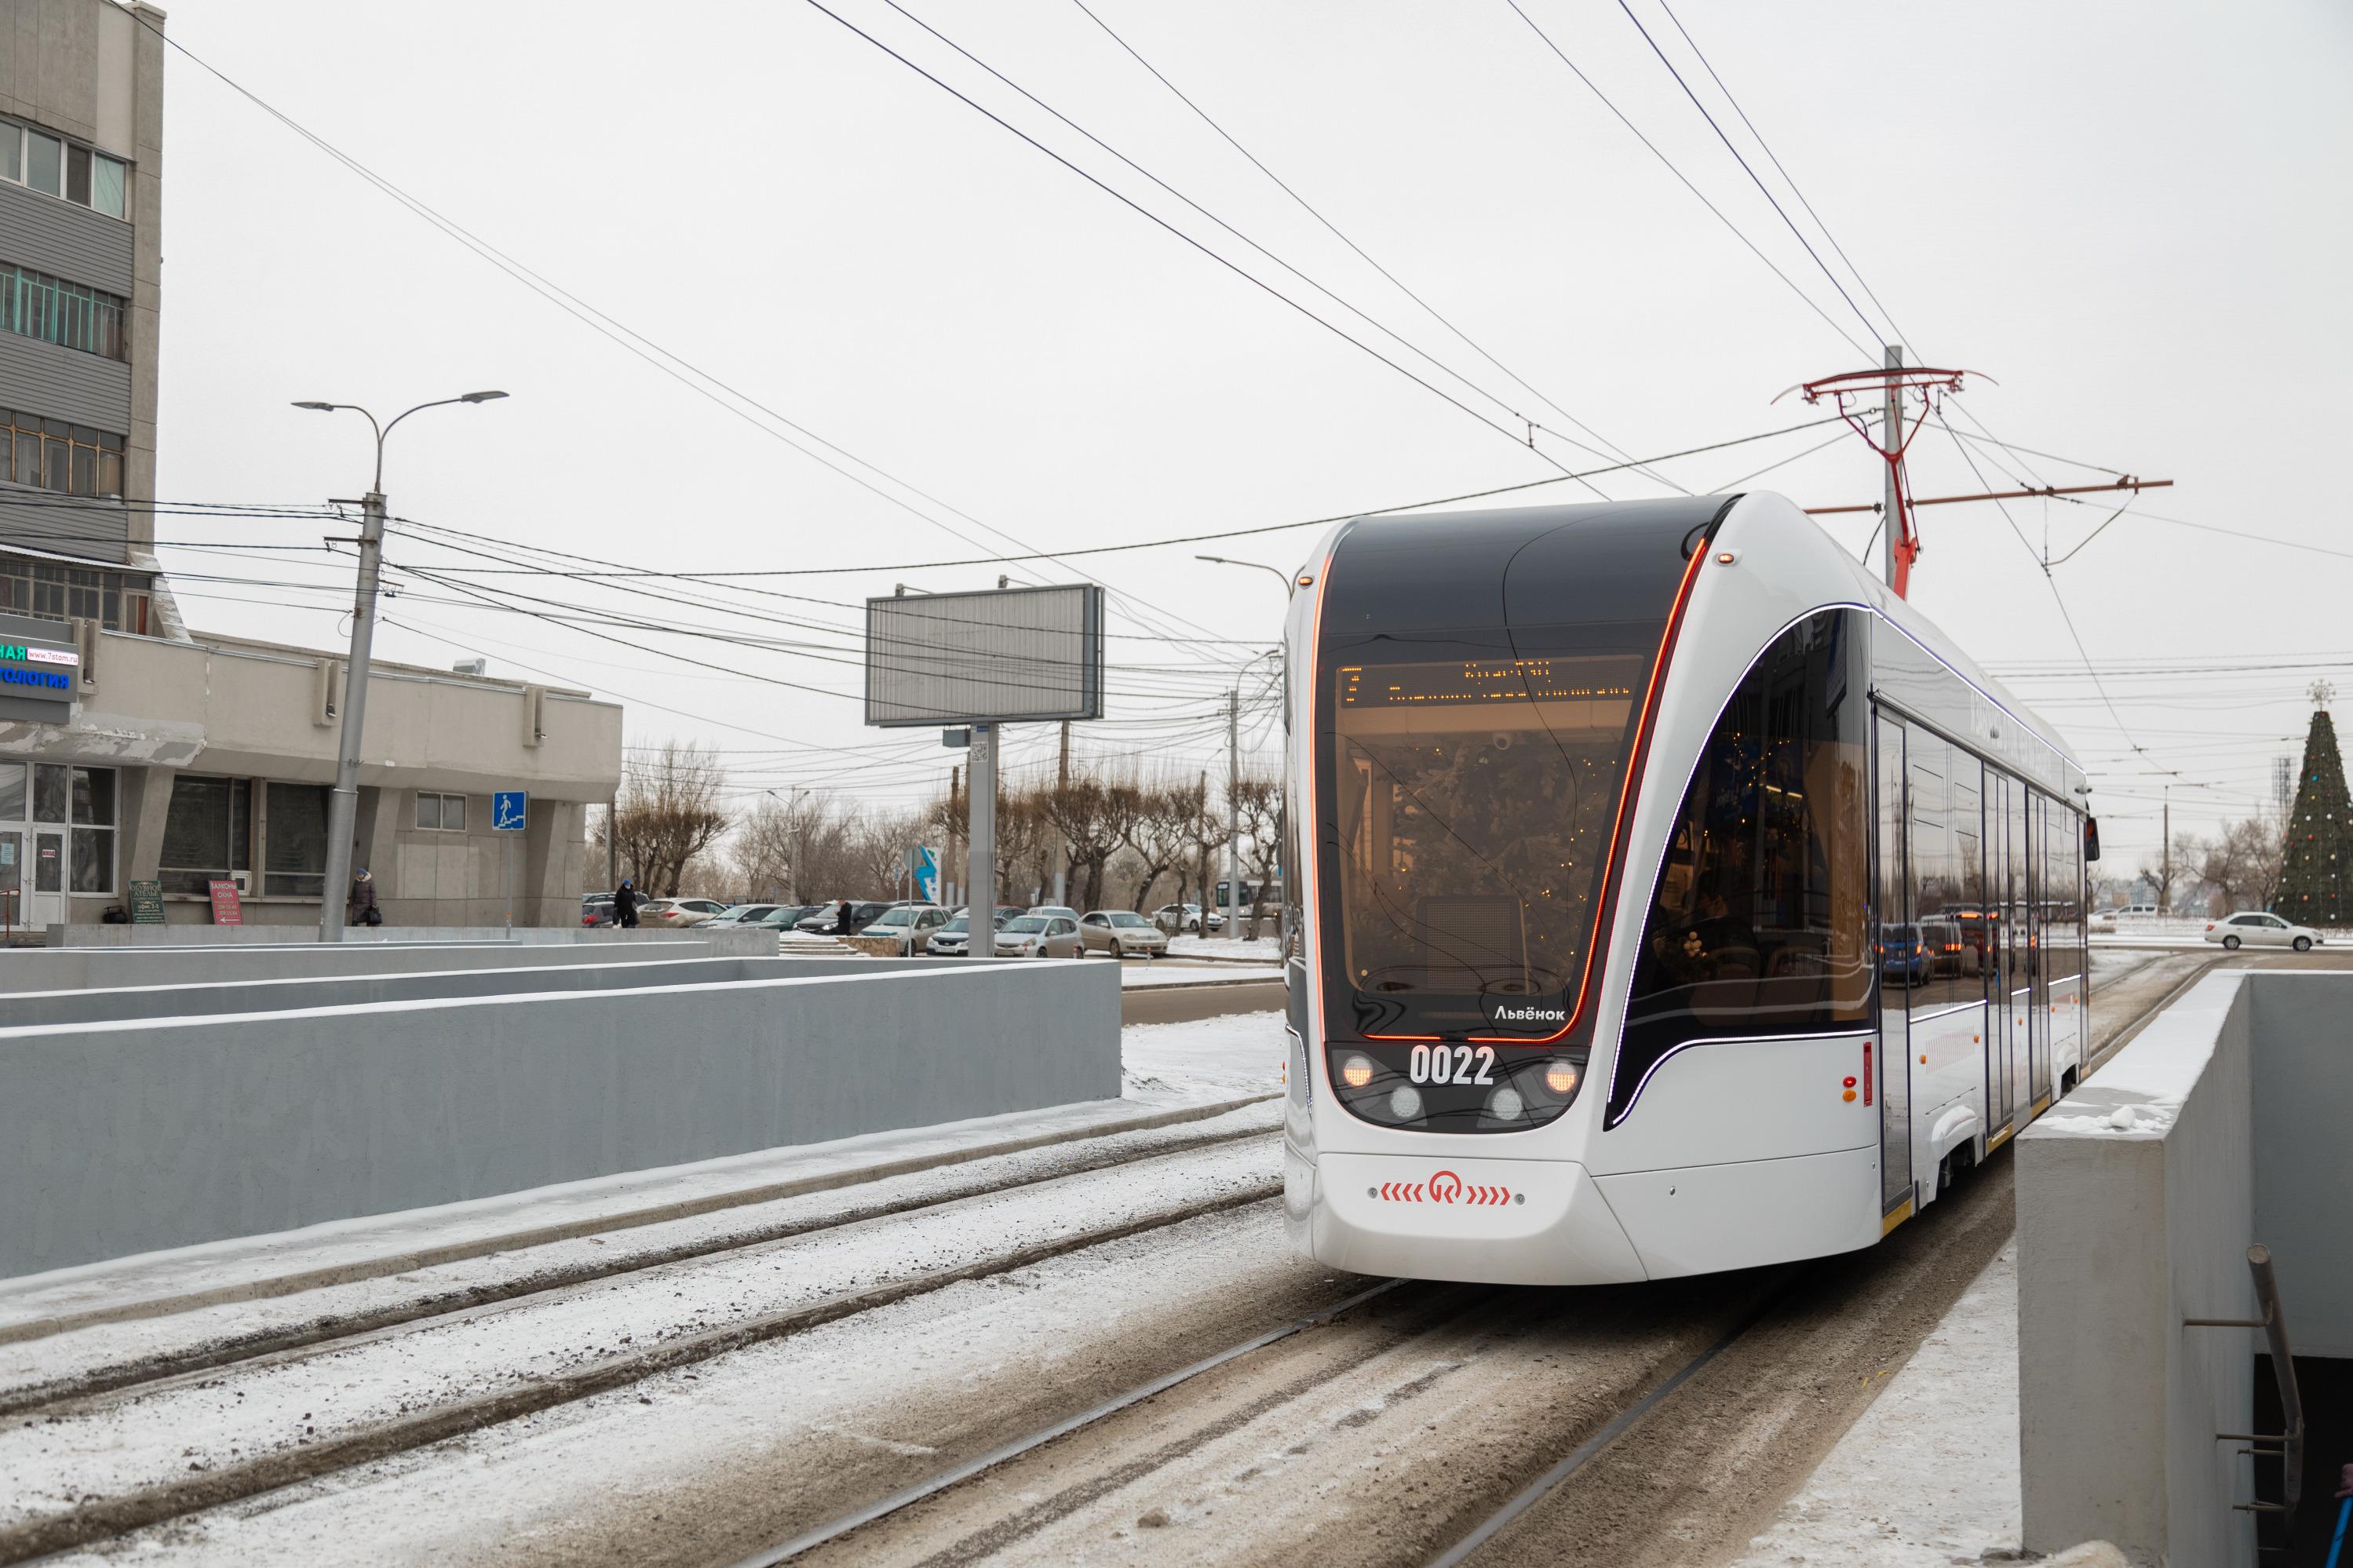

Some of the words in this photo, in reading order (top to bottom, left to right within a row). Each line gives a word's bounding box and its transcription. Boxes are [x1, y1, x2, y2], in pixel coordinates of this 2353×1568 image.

[29, 652, 78, 662] www.7stom.ru
[1494, 1005, 1565, 1022] Львёнок
[1410, 1045, 1495, 1085] 0022
